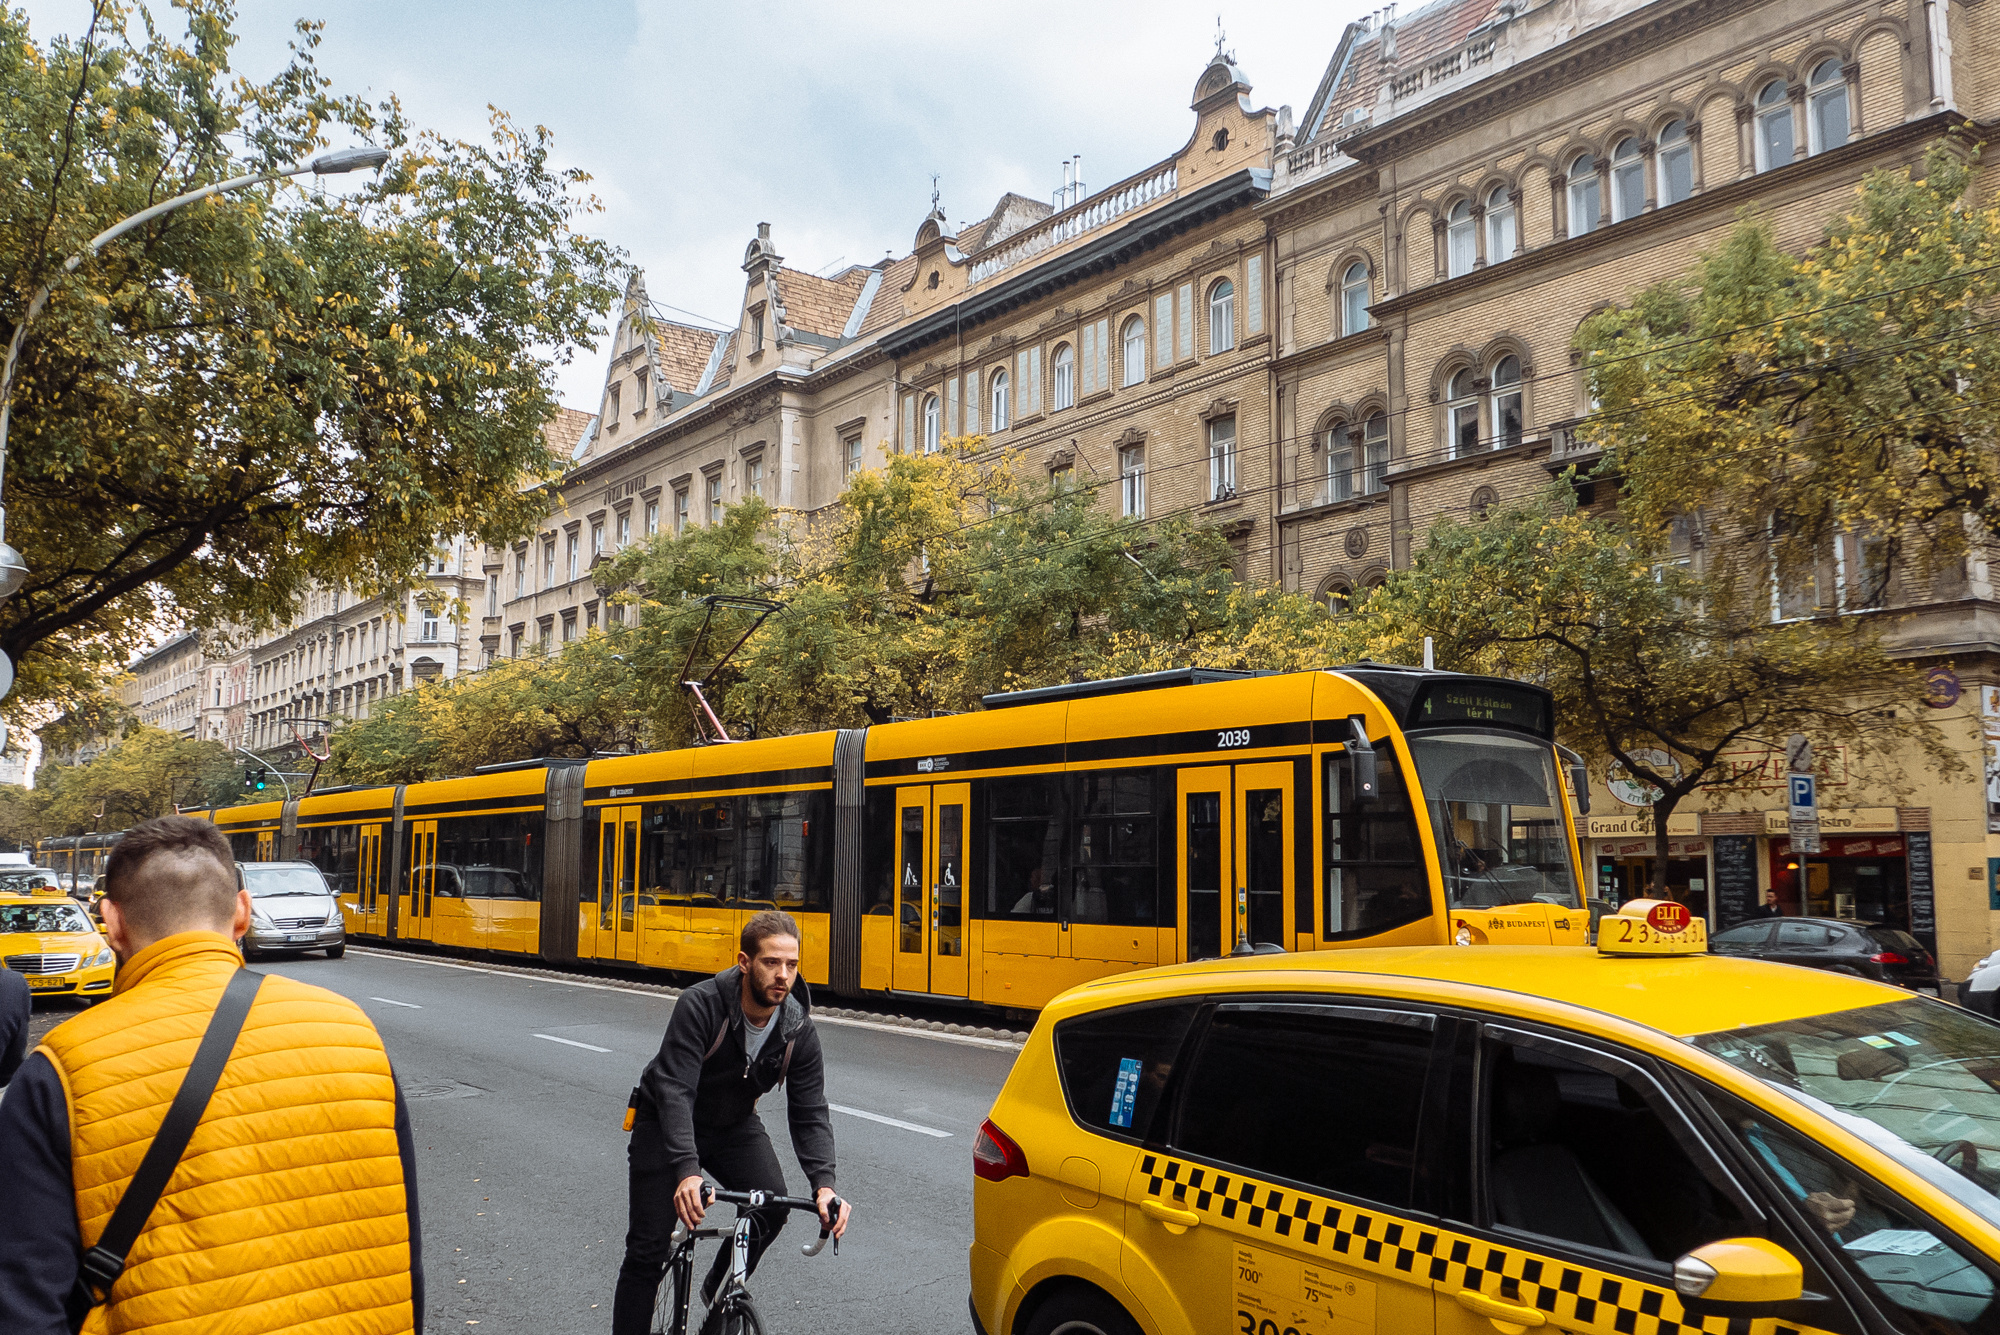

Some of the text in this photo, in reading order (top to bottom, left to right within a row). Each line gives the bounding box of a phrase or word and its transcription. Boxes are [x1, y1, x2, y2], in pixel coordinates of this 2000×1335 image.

[1423, 697, 1433, 715] 4
[1446, 693, 1473, 706] Széll
[1486, 709, 1494, 719] M
[1217, 729, 1250, 748] 2039
[1591, 819, 1627, 834] Grand
[1656, 905, 1682, 920] ELIT
[1507, 920, 1546, 928] BUDAPEST
